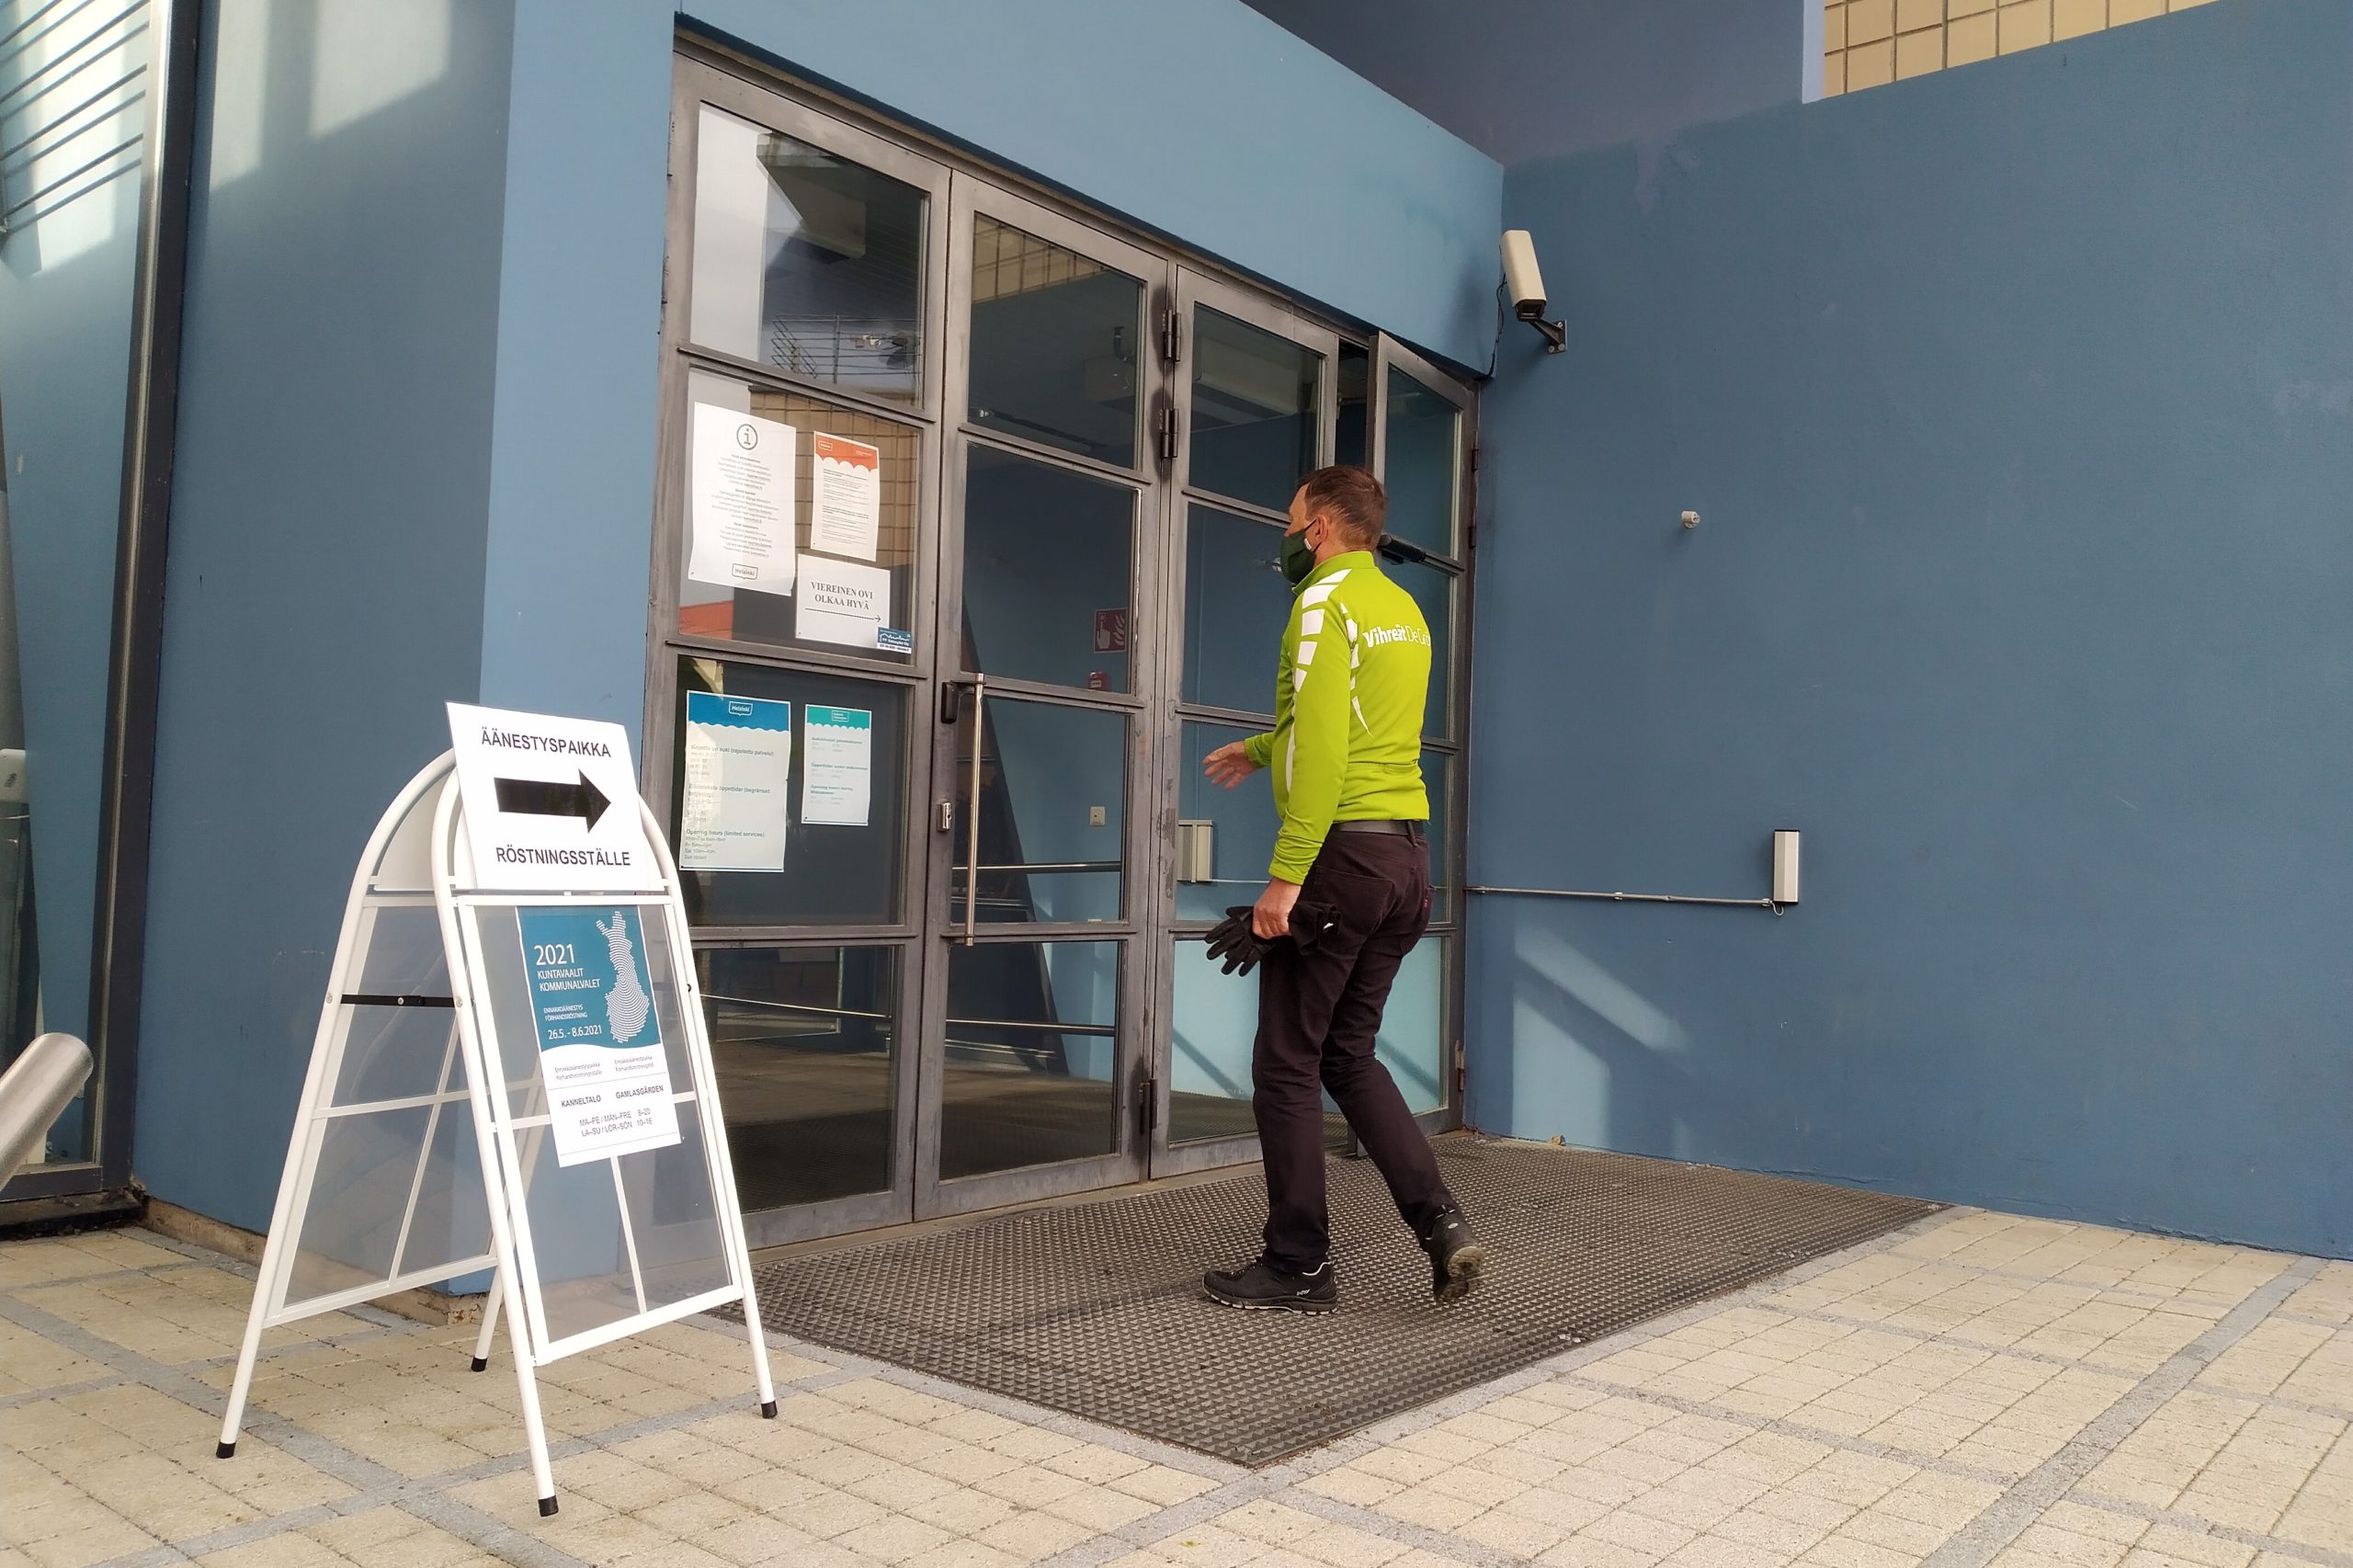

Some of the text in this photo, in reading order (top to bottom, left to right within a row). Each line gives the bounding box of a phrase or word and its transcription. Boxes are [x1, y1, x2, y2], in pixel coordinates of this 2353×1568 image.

[811, 582, 873, 599] VIEREINEN OVI
[814, 594, 870, 610] OLKAA HYVÄ
[481, 726, 612, 757] ÄÄNESTYSPAIKKA
[495, 844, 631, 866] RÖSTNINGSSTÄLLE
[533, 944, 575, 965] 2021
[537, 968, 584, 981] KUNTAVAALIT
[540, 979, 601, 992] KOMMUNALVALET
[548, 1028, 567, 1040] 26.5.
[572, 1024, 602, 1037] 8.6.2021
[615, 1085, 664, 1099] GAMLASGÅRDEN
[561, 1095, 602, 1108] KANNELTALO
